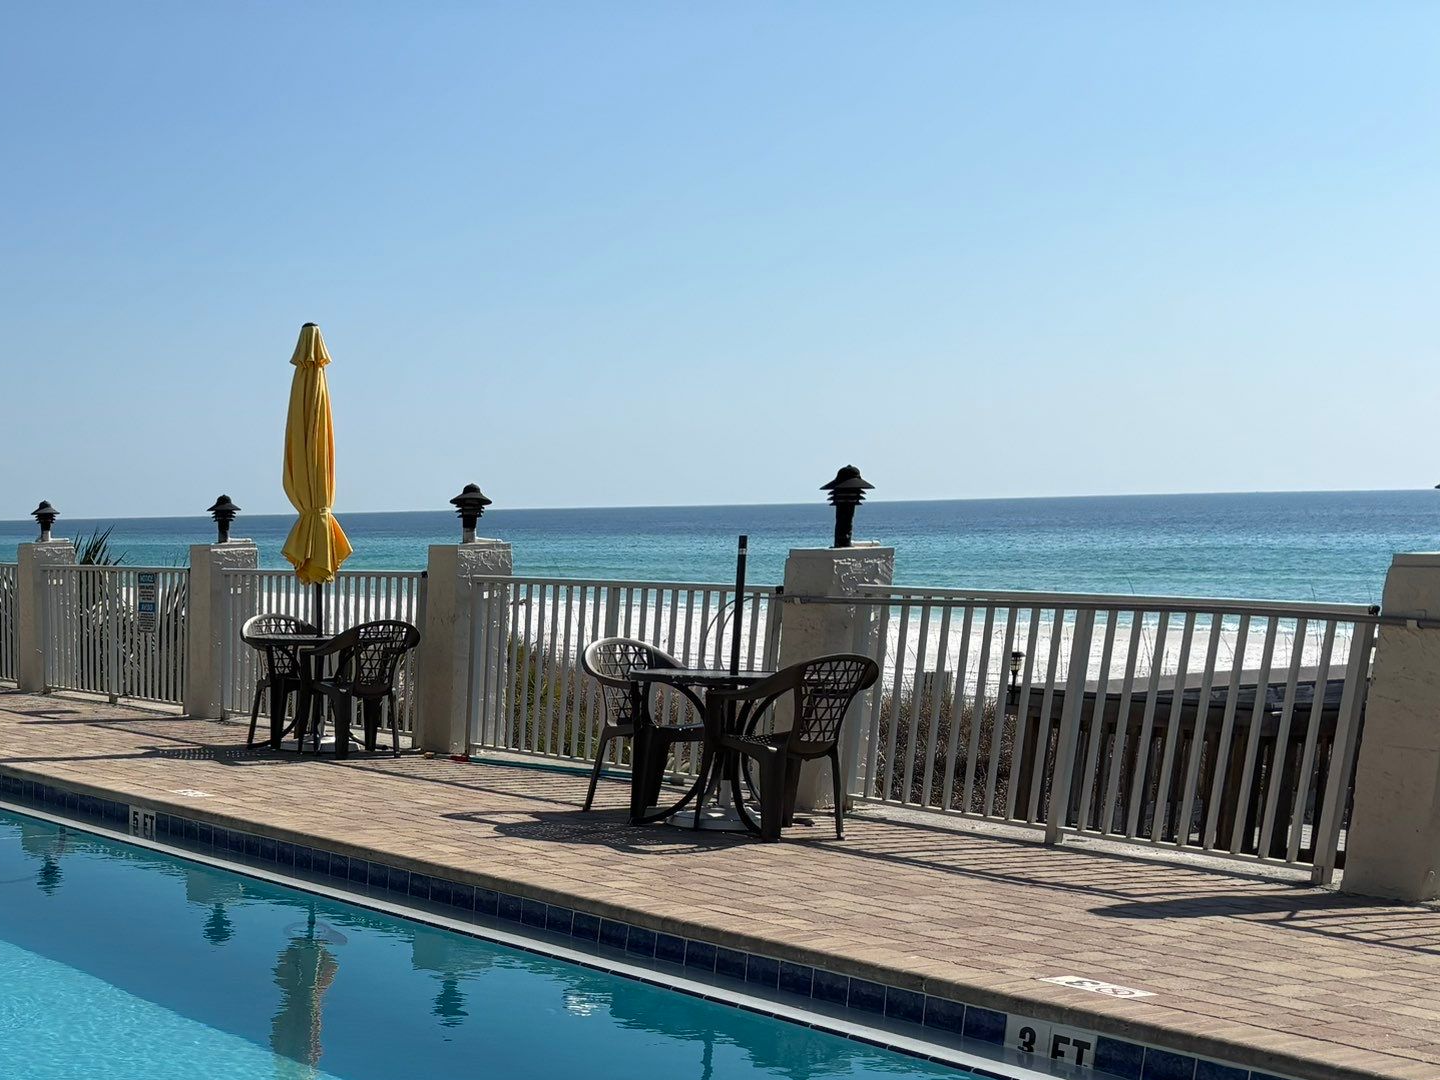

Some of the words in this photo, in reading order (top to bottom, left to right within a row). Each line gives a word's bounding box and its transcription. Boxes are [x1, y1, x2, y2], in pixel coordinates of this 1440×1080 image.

[133, 810, 139, 827] 5
[143, 813, 155, 832] FT
[1017, 1026, 1037, 1053] 3
[1050, 1034, 1091, 1065] FT
